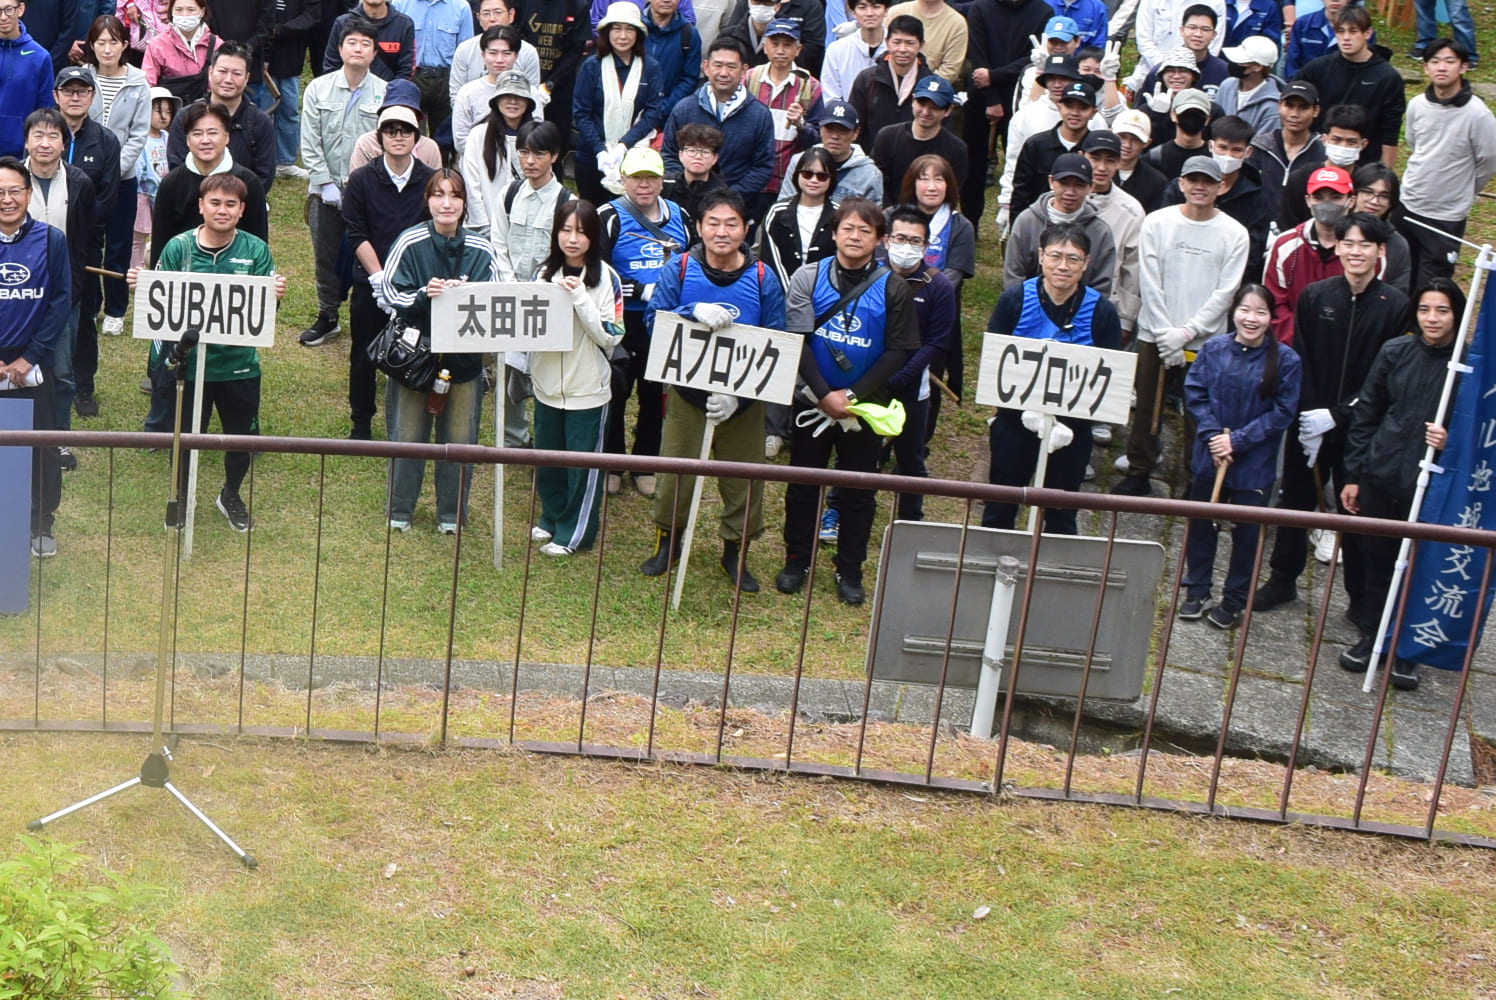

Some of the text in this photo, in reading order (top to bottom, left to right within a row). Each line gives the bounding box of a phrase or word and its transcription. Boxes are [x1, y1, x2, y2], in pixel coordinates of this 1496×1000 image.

[629, 260, 664, 270] SUBA
[147, 279, 267, 337] SUBARU
[457, 294, 550, 338] 太田市
[661, 323, 780, 396] Aブロック
[814, 327, 873, 348] SUBARU
[997, 343, 1112, 417] Cブロック
